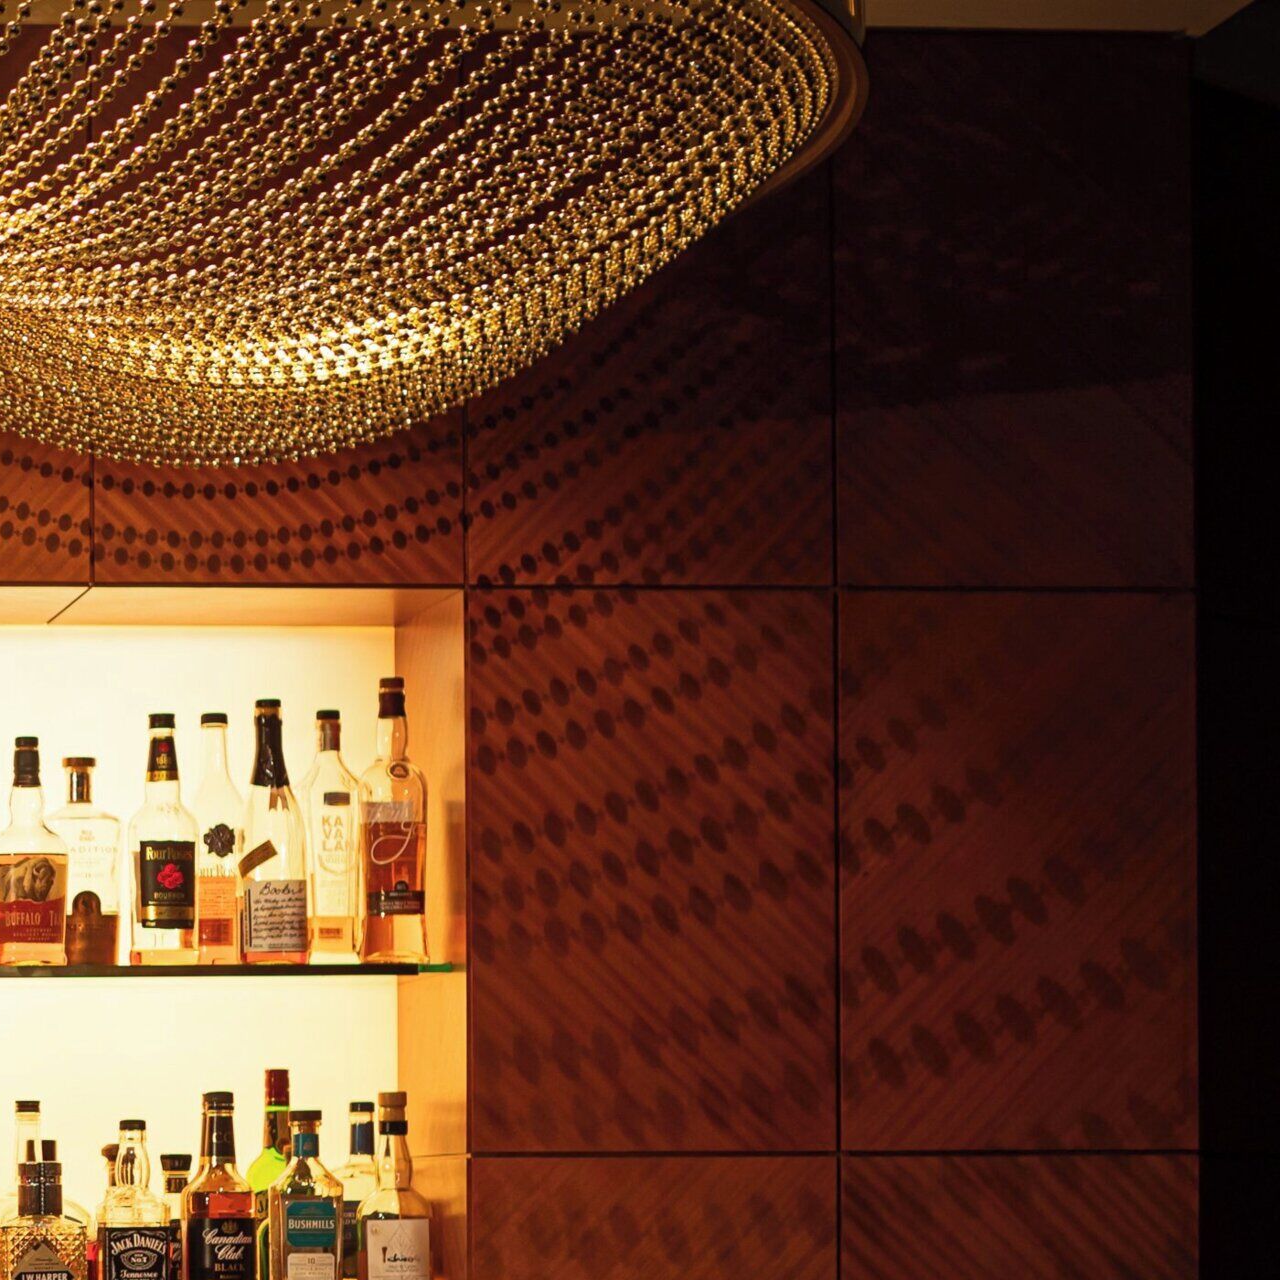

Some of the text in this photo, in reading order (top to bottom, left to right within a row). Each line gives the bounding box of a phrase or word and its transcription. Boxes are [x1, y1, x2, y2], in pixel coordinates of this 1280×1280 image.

[4, 910, 41, 927] BUFFALO
[288, 1218, 335, 1229] BUSHMILLS
[110, 1233, 168, 1255] JACK DANIEL'S
[202, 1226, 253, 1245] Canadian
[119, 1269, 158, 1279] Tennessee
